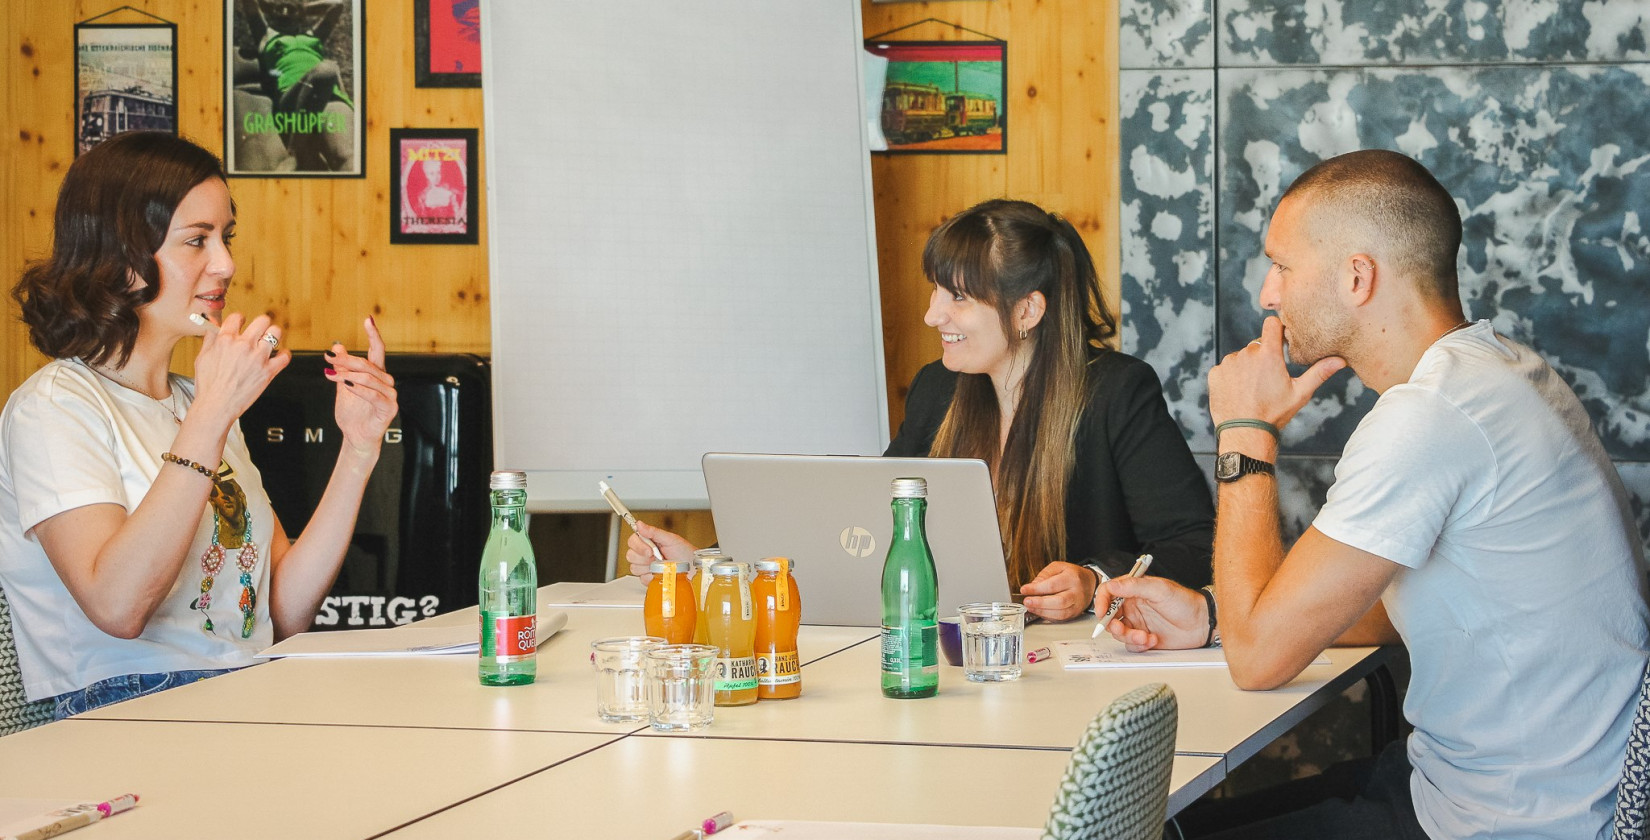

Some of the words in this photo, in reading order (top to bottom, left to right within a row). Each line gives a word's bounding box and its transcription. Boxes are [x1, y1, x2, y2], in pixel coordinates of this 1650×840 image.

[243, 109, 347, 134] GRASHÜPFER
[403, 216, 468, 225] THERESIA
[266, 427, 403, 444] SMG
[843, 525, 873, 558] hp
